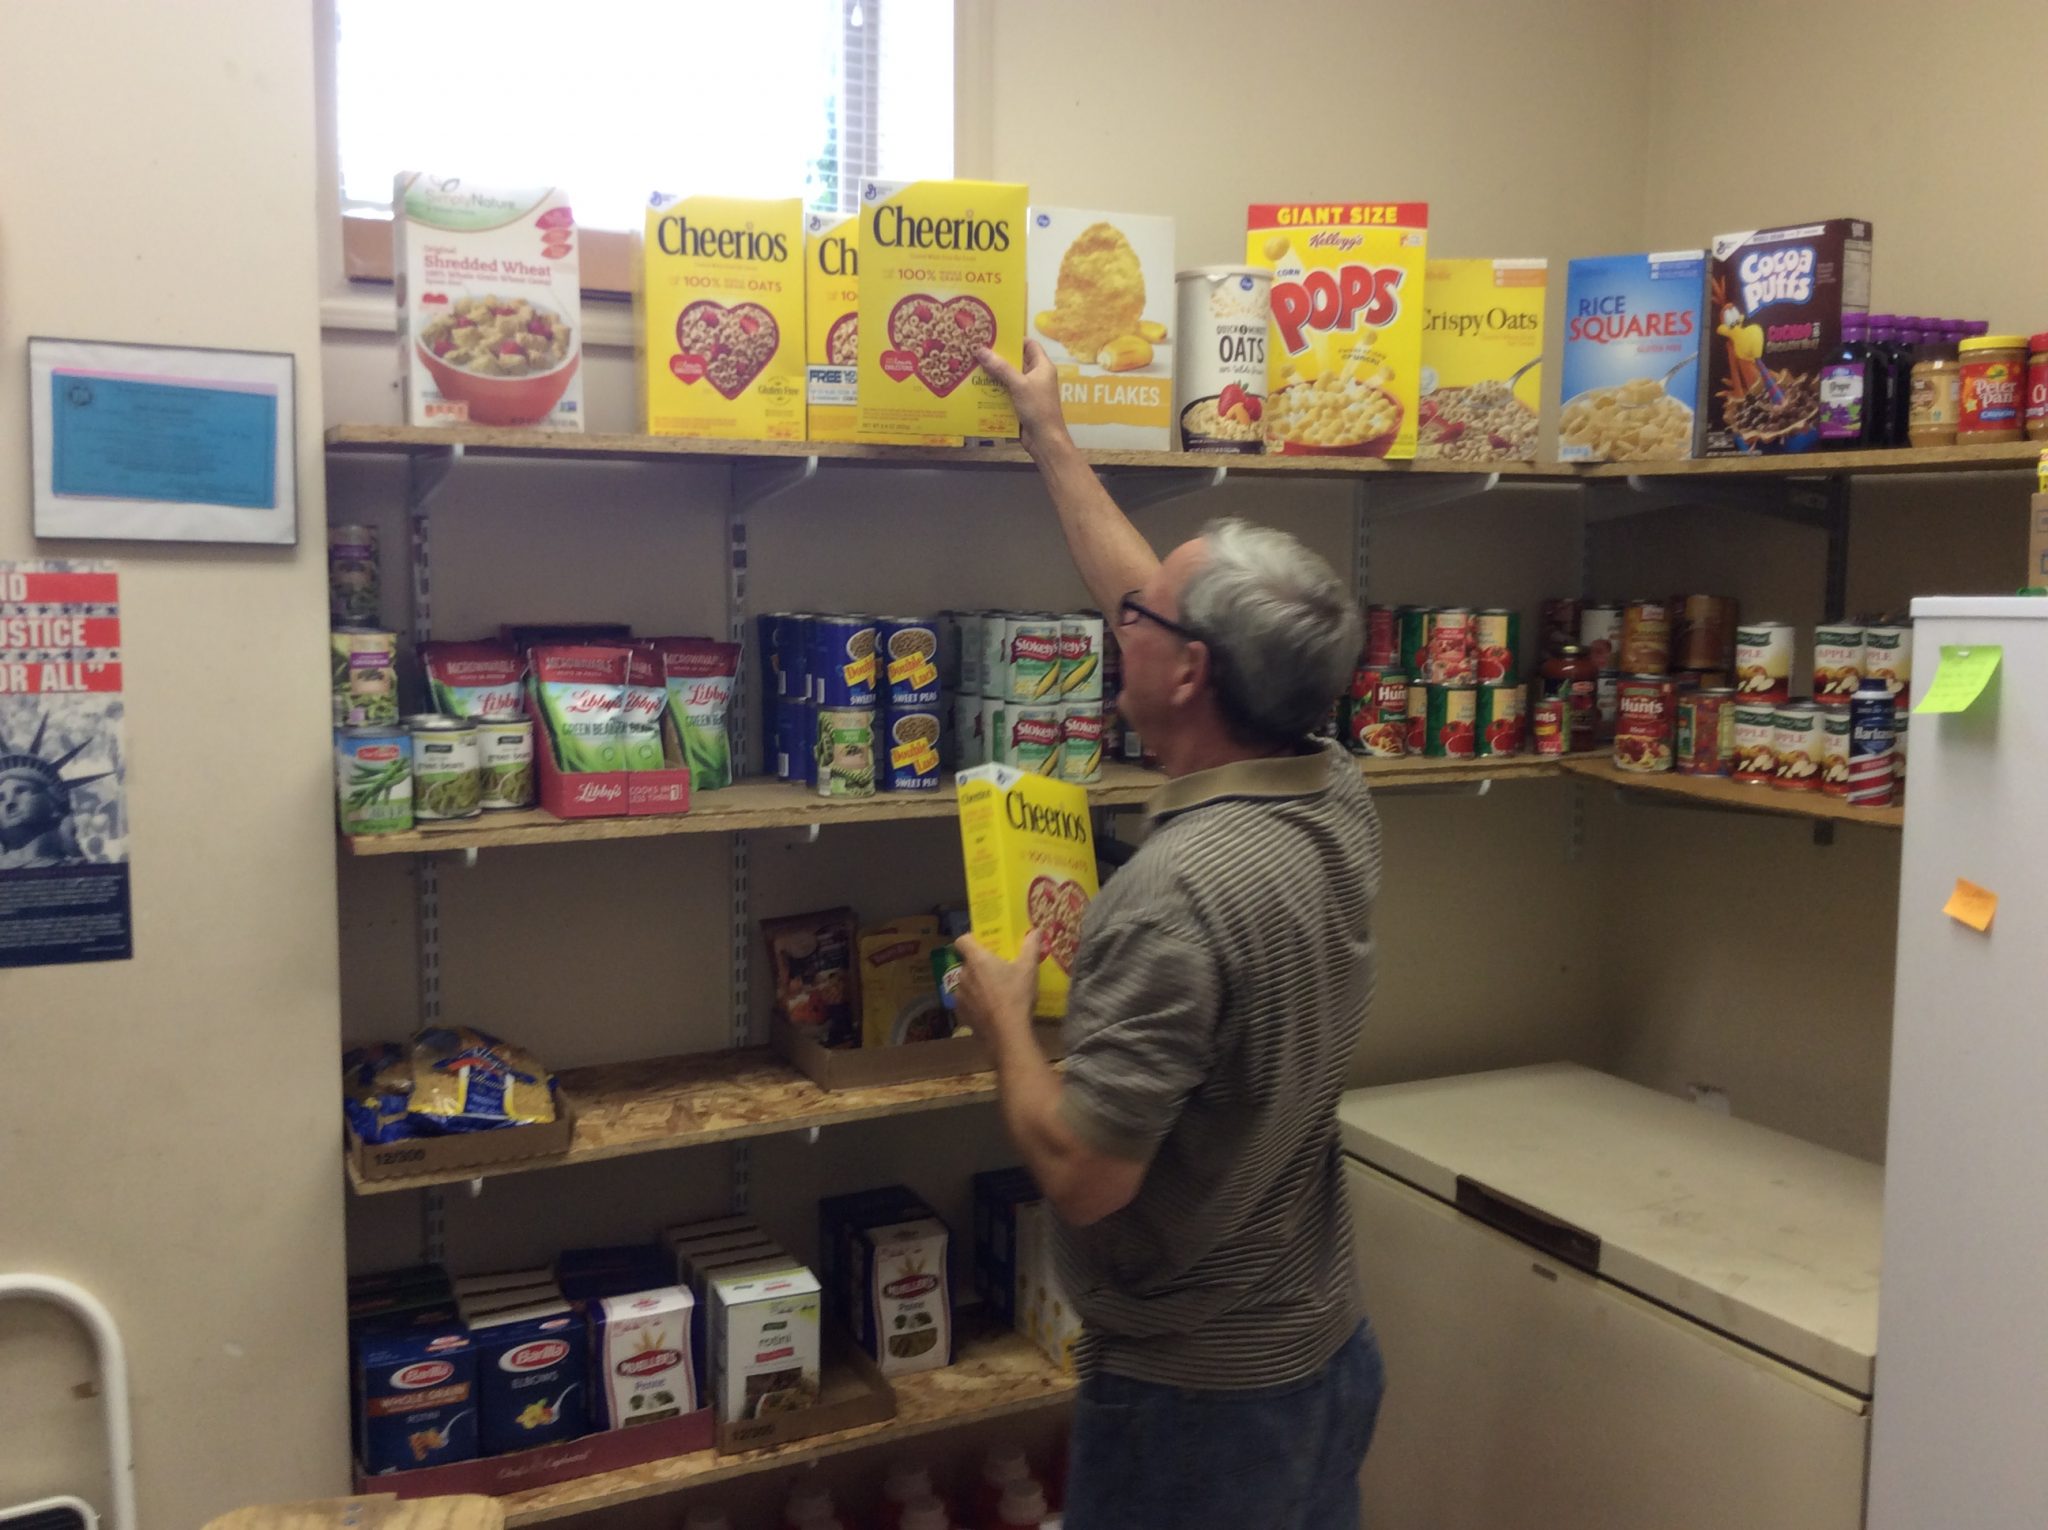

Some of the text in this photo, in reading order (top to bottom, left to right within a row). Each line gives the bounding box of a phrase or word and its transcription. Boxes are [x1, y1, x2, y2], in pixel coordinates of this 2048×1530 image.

[1277, 206, 1399, 226] GIANT SIZE
[657, 216, 788, 263] Cheerios
[873, 205, 1010, 252] Cheerios
[1309, 231, 1364, 250] Kellogg's
[424, 255, 551, 277] Shredded Wheat
[819, 238, 859, 275] Ch
[1741, 248, 1813, 283] Cocoa
[684, 276, 720, 289] 100%
[747, 280, 782, 293] OATS
[898, 269, 936, 282] 100%
[965, 271, 1002, 284] OATS
[1744, 272, 1811, 314] Puffs
[1270, 265, 1404, 356] POPS
[1579, 296, 1627, 317] RICE
[1487, 307, 1538, 330] Oats
[1569, 310, 1694, 344] SQUARES
[1219, 335, 1265, 364] OATS
[808, 369, 842, 384] FREE
[1975, 379, 2017, 394] Peter
[1061, 383, 1160, 406] RN FLAKES
[1979, 393, 2013, 408] Pan
[575, 782, 622, 802] Libby's
[1006, 790, 1087, 844] Cheerios
[515, 1343, 566, 1364] Barilla
[405, 1365, 449, 1383] Barilla
